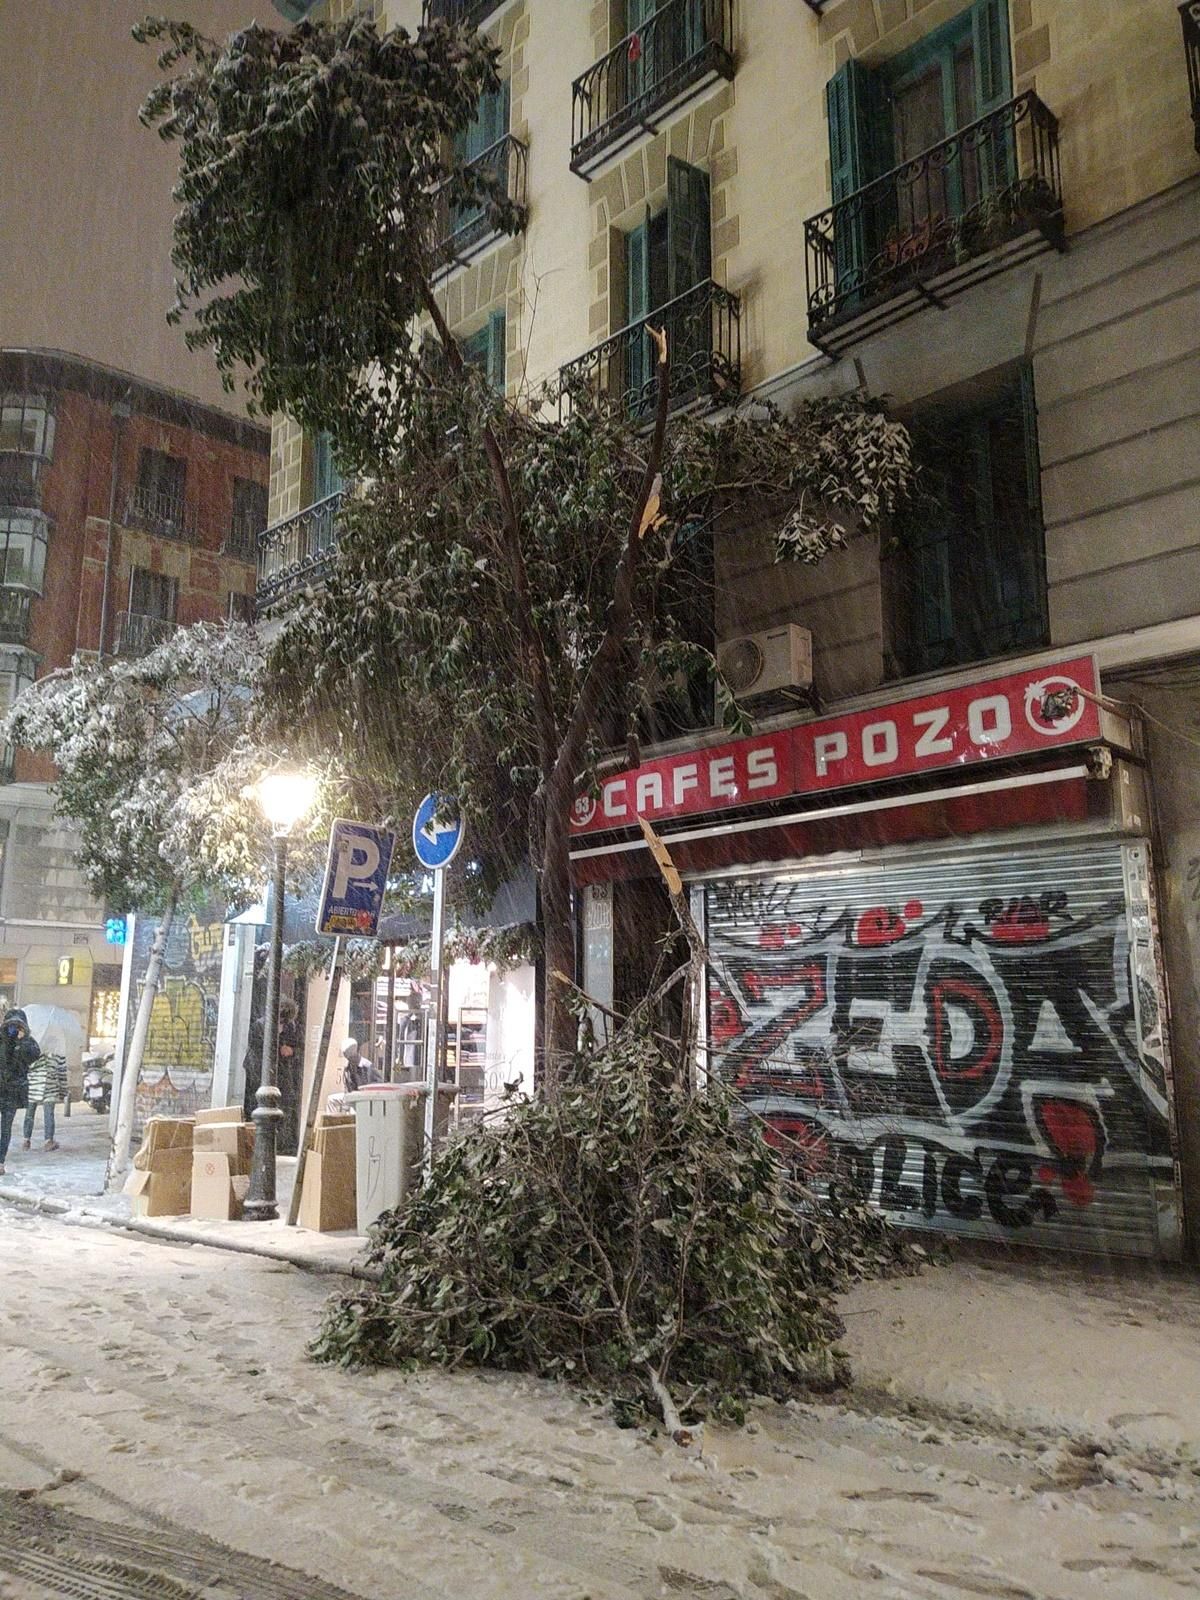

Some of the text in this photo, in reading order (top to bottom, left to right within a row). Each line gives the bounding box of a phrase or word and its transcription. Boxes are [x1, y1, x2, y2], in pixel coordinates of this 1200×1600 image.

[603, 694, 1012, 818] CAFES POZO
[332, 833, 380, 899] P
